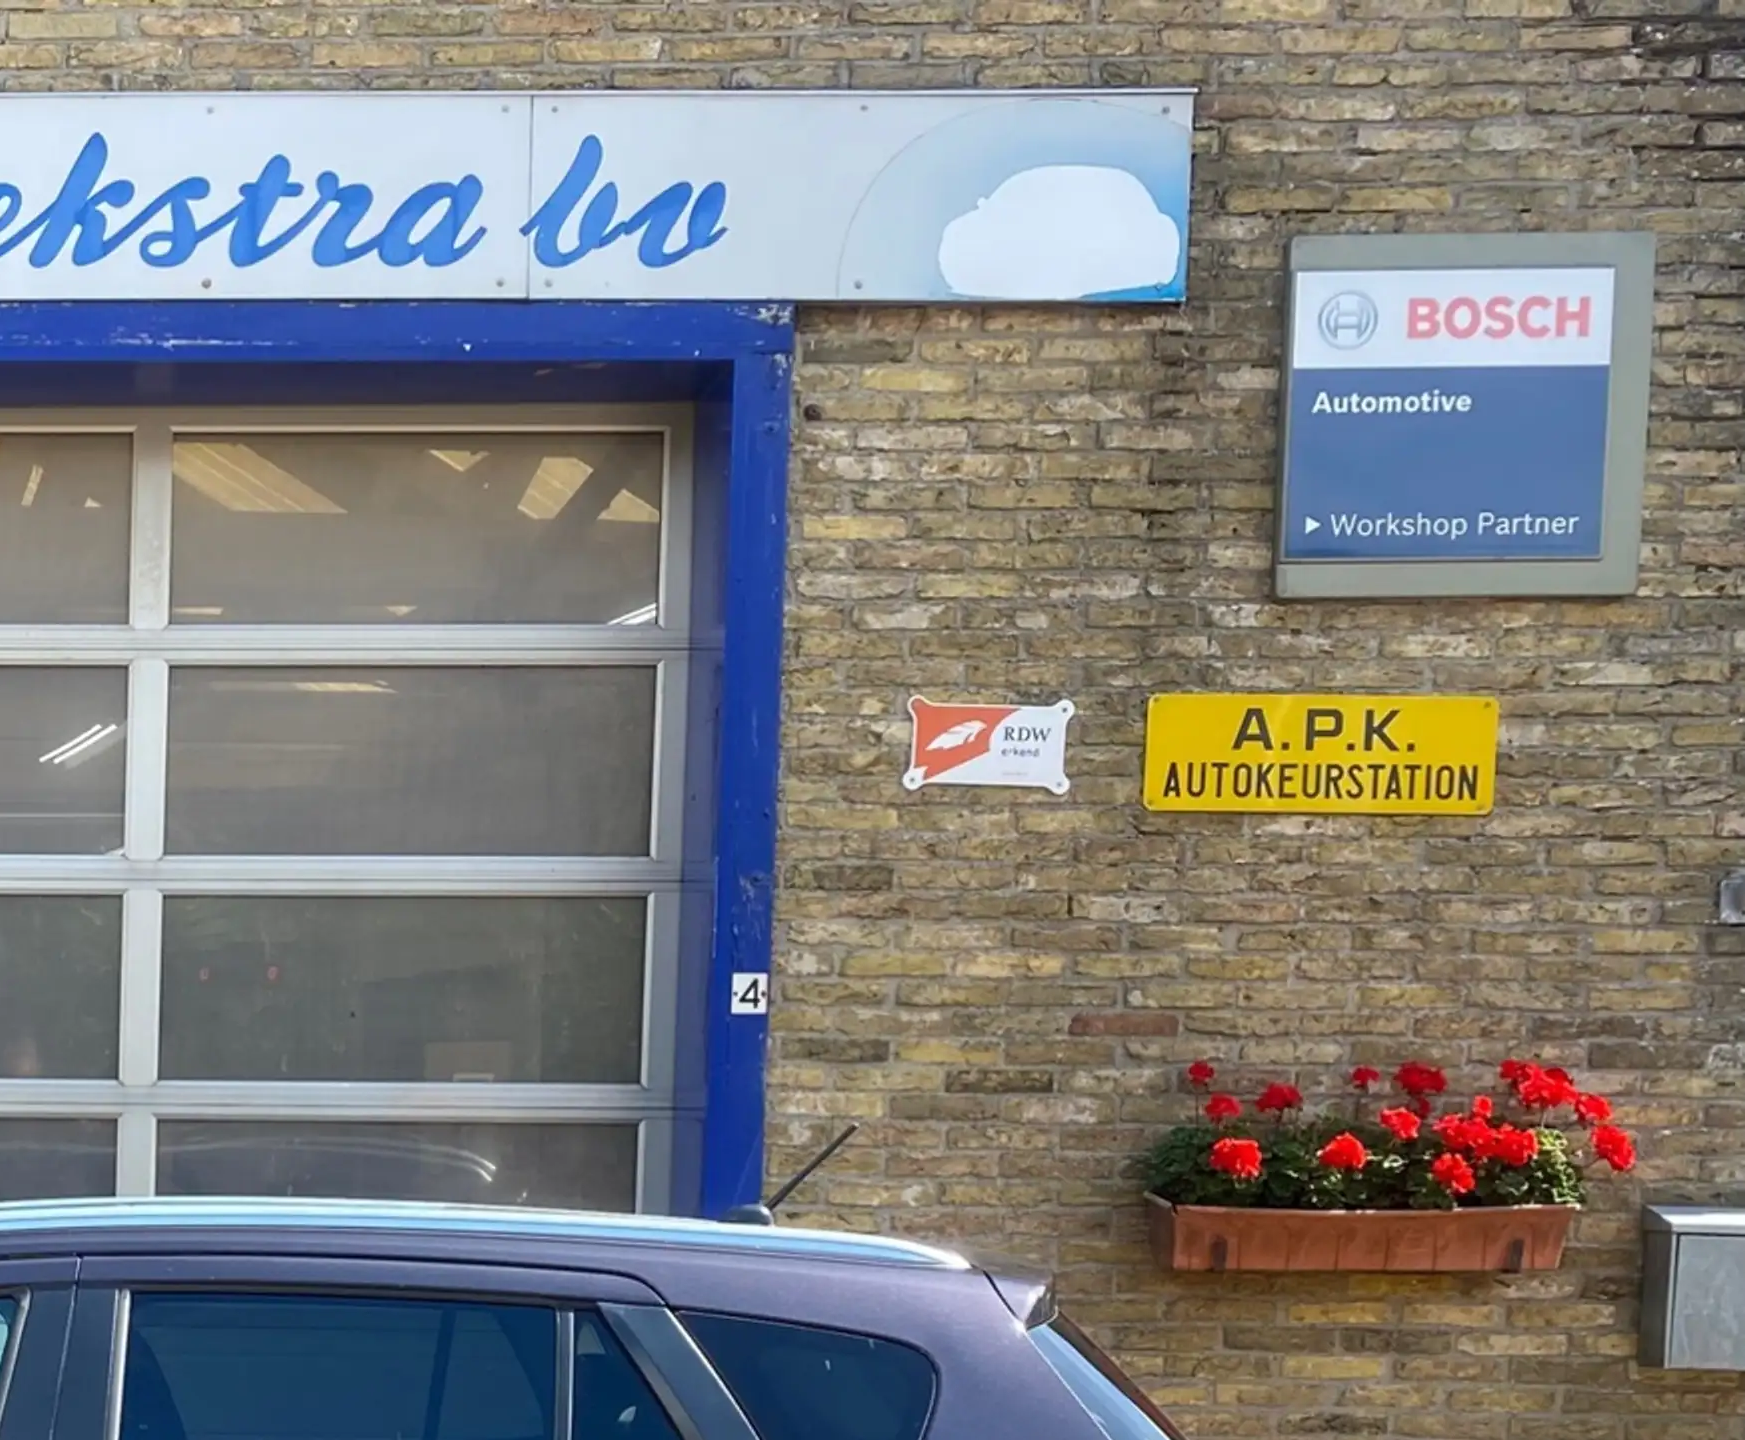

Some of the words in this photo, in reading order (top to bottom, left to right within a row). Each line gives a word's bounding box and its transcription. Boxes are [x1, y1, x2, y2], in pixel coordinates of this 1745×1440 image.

[519, 134, 728, 268] bv
[1406, 296, 1592, 340] BOSCH
[1311, 389, 1473, 414] Automotive
[1330, 511, 1468, 540] Workshop
[1477, 511, 1580, 535] Partner
[1003, 727, 1051, 742] RDW
[1231, 707, 1417, 752] A.P.K.
[1163, 762, 1479, 802] AUTOKEURSTATION
[739, 978, 761, 1009] 4
